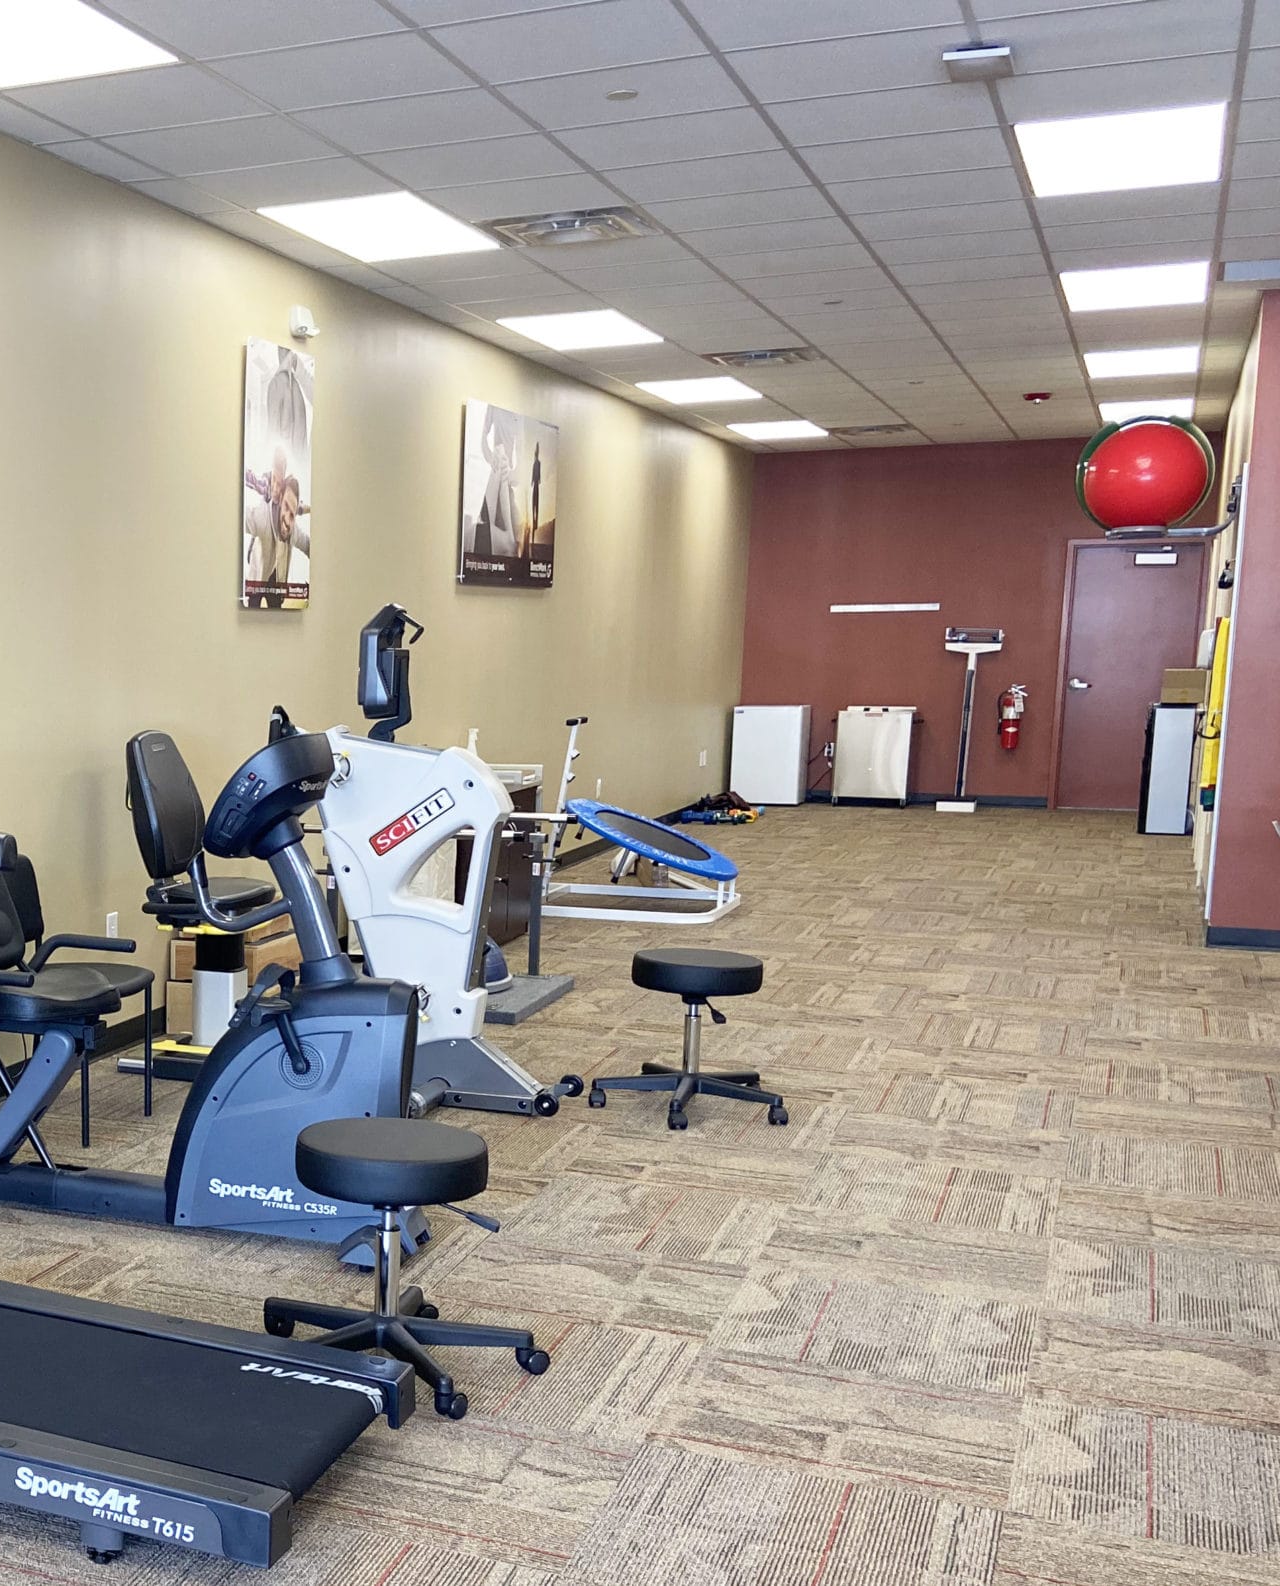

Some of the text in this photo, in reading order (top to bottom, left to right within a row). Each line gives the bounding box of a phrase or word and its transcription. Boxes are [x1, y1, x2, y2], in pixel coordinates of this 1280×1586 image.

[375, 794, 446, 851] SCIFIT
[209, 1178, 295, 1203] SportsArt
[262, 1201, 338, 1216] FITNESS C535R
[15, 1466, 141, 1516] SportsArt
[92, 1508, 195, 1543] FITNESS T615
